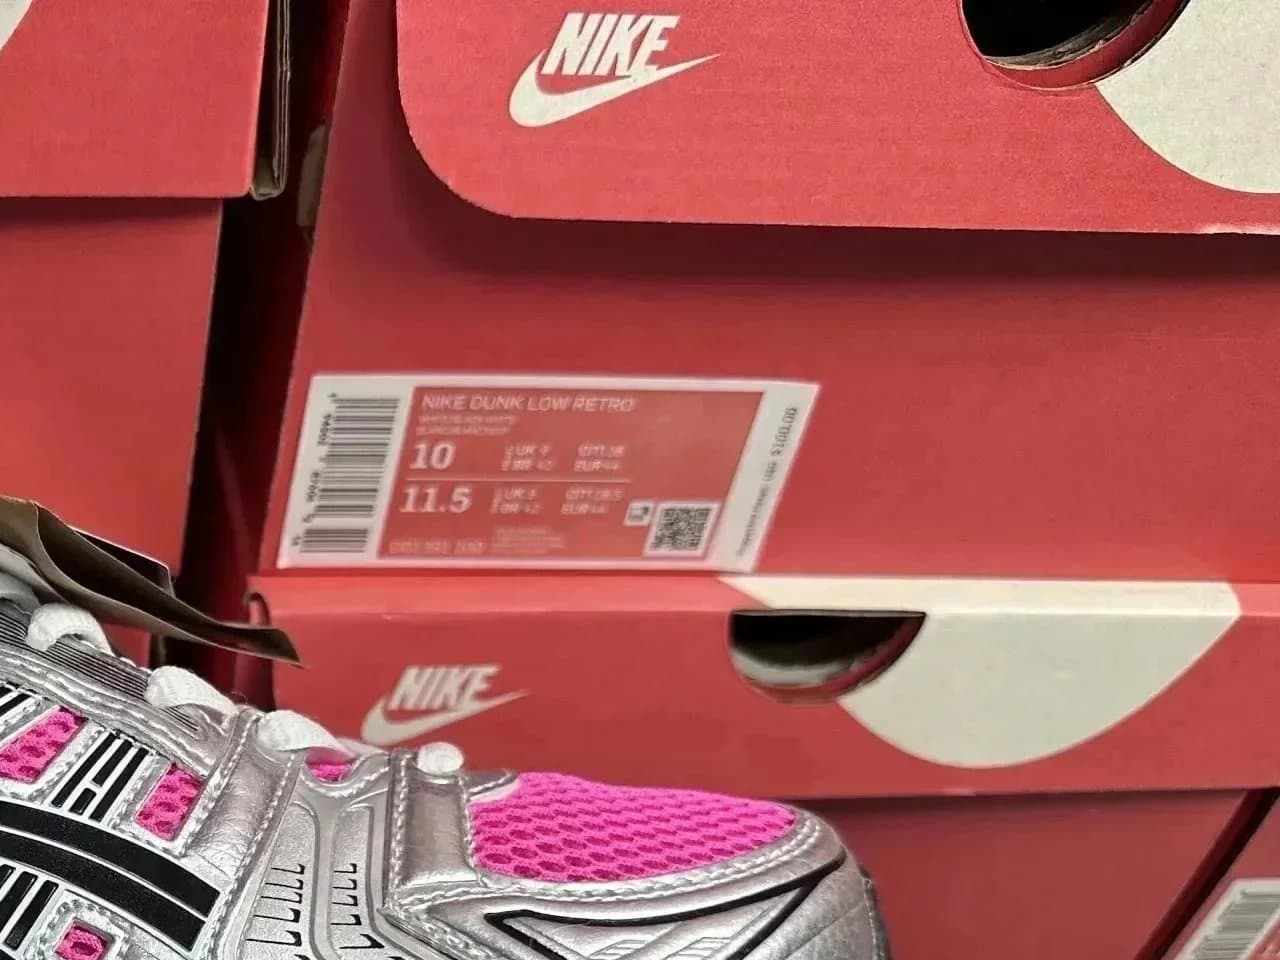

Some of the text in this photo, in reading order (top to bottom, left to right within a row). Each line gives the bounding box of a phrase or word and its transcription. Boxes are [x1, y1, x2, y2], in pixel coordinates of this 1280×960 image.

[540, 12, 680, 76] NIKE
[422, 395, 634, 412] NIKE DUNK LOW RETRO
[409, 443, 456, 470] 10
[400, 487, 471, 513] 11.5
[387, 664, 500, 711] NIKE
